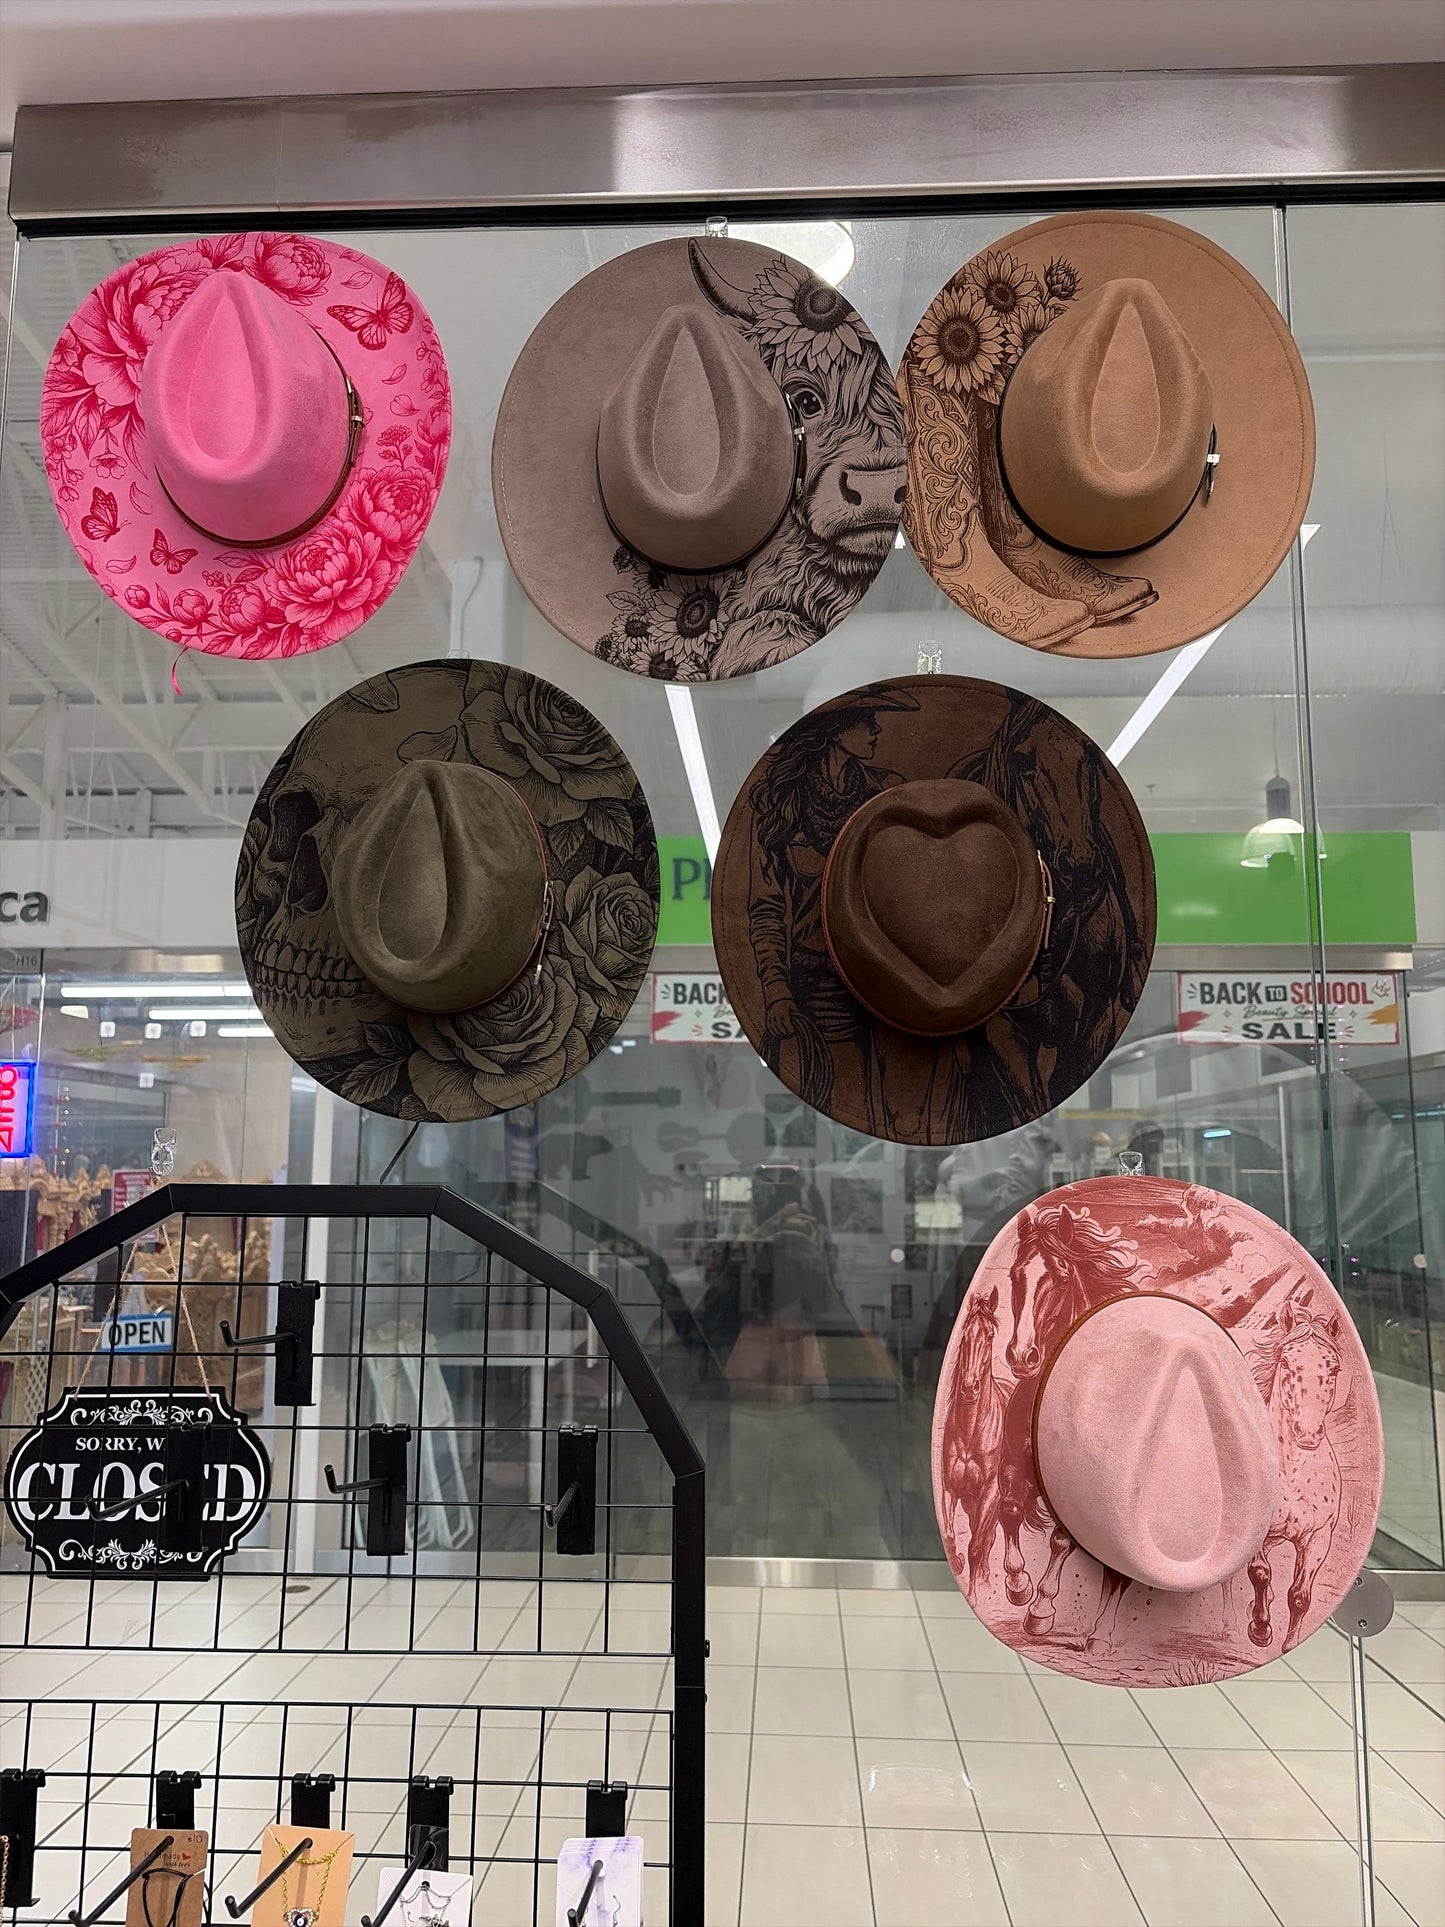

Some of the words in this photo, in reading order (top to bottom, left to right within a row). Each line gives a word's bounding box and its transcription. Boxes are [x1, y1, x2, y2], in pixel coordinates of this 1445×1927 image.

[1200, 982, 1263, 1005] BACK
[1267, 987, 1285, 1001] TO
[1290, 981, 1374, 1005] SCHOOL
[1243, 1004, 1289, 1019] Beauty
[1241, 1022, 1337, 1040] SALE
[109, 1321, 165, 1346] OPEN
[75, 1437, 142, 1454] SORRY,
[146, 1437, 166, 1451] W
[17, 1461, 256, 1522] CLOSD
[144, 1850, 180, 1860] Hdmade
